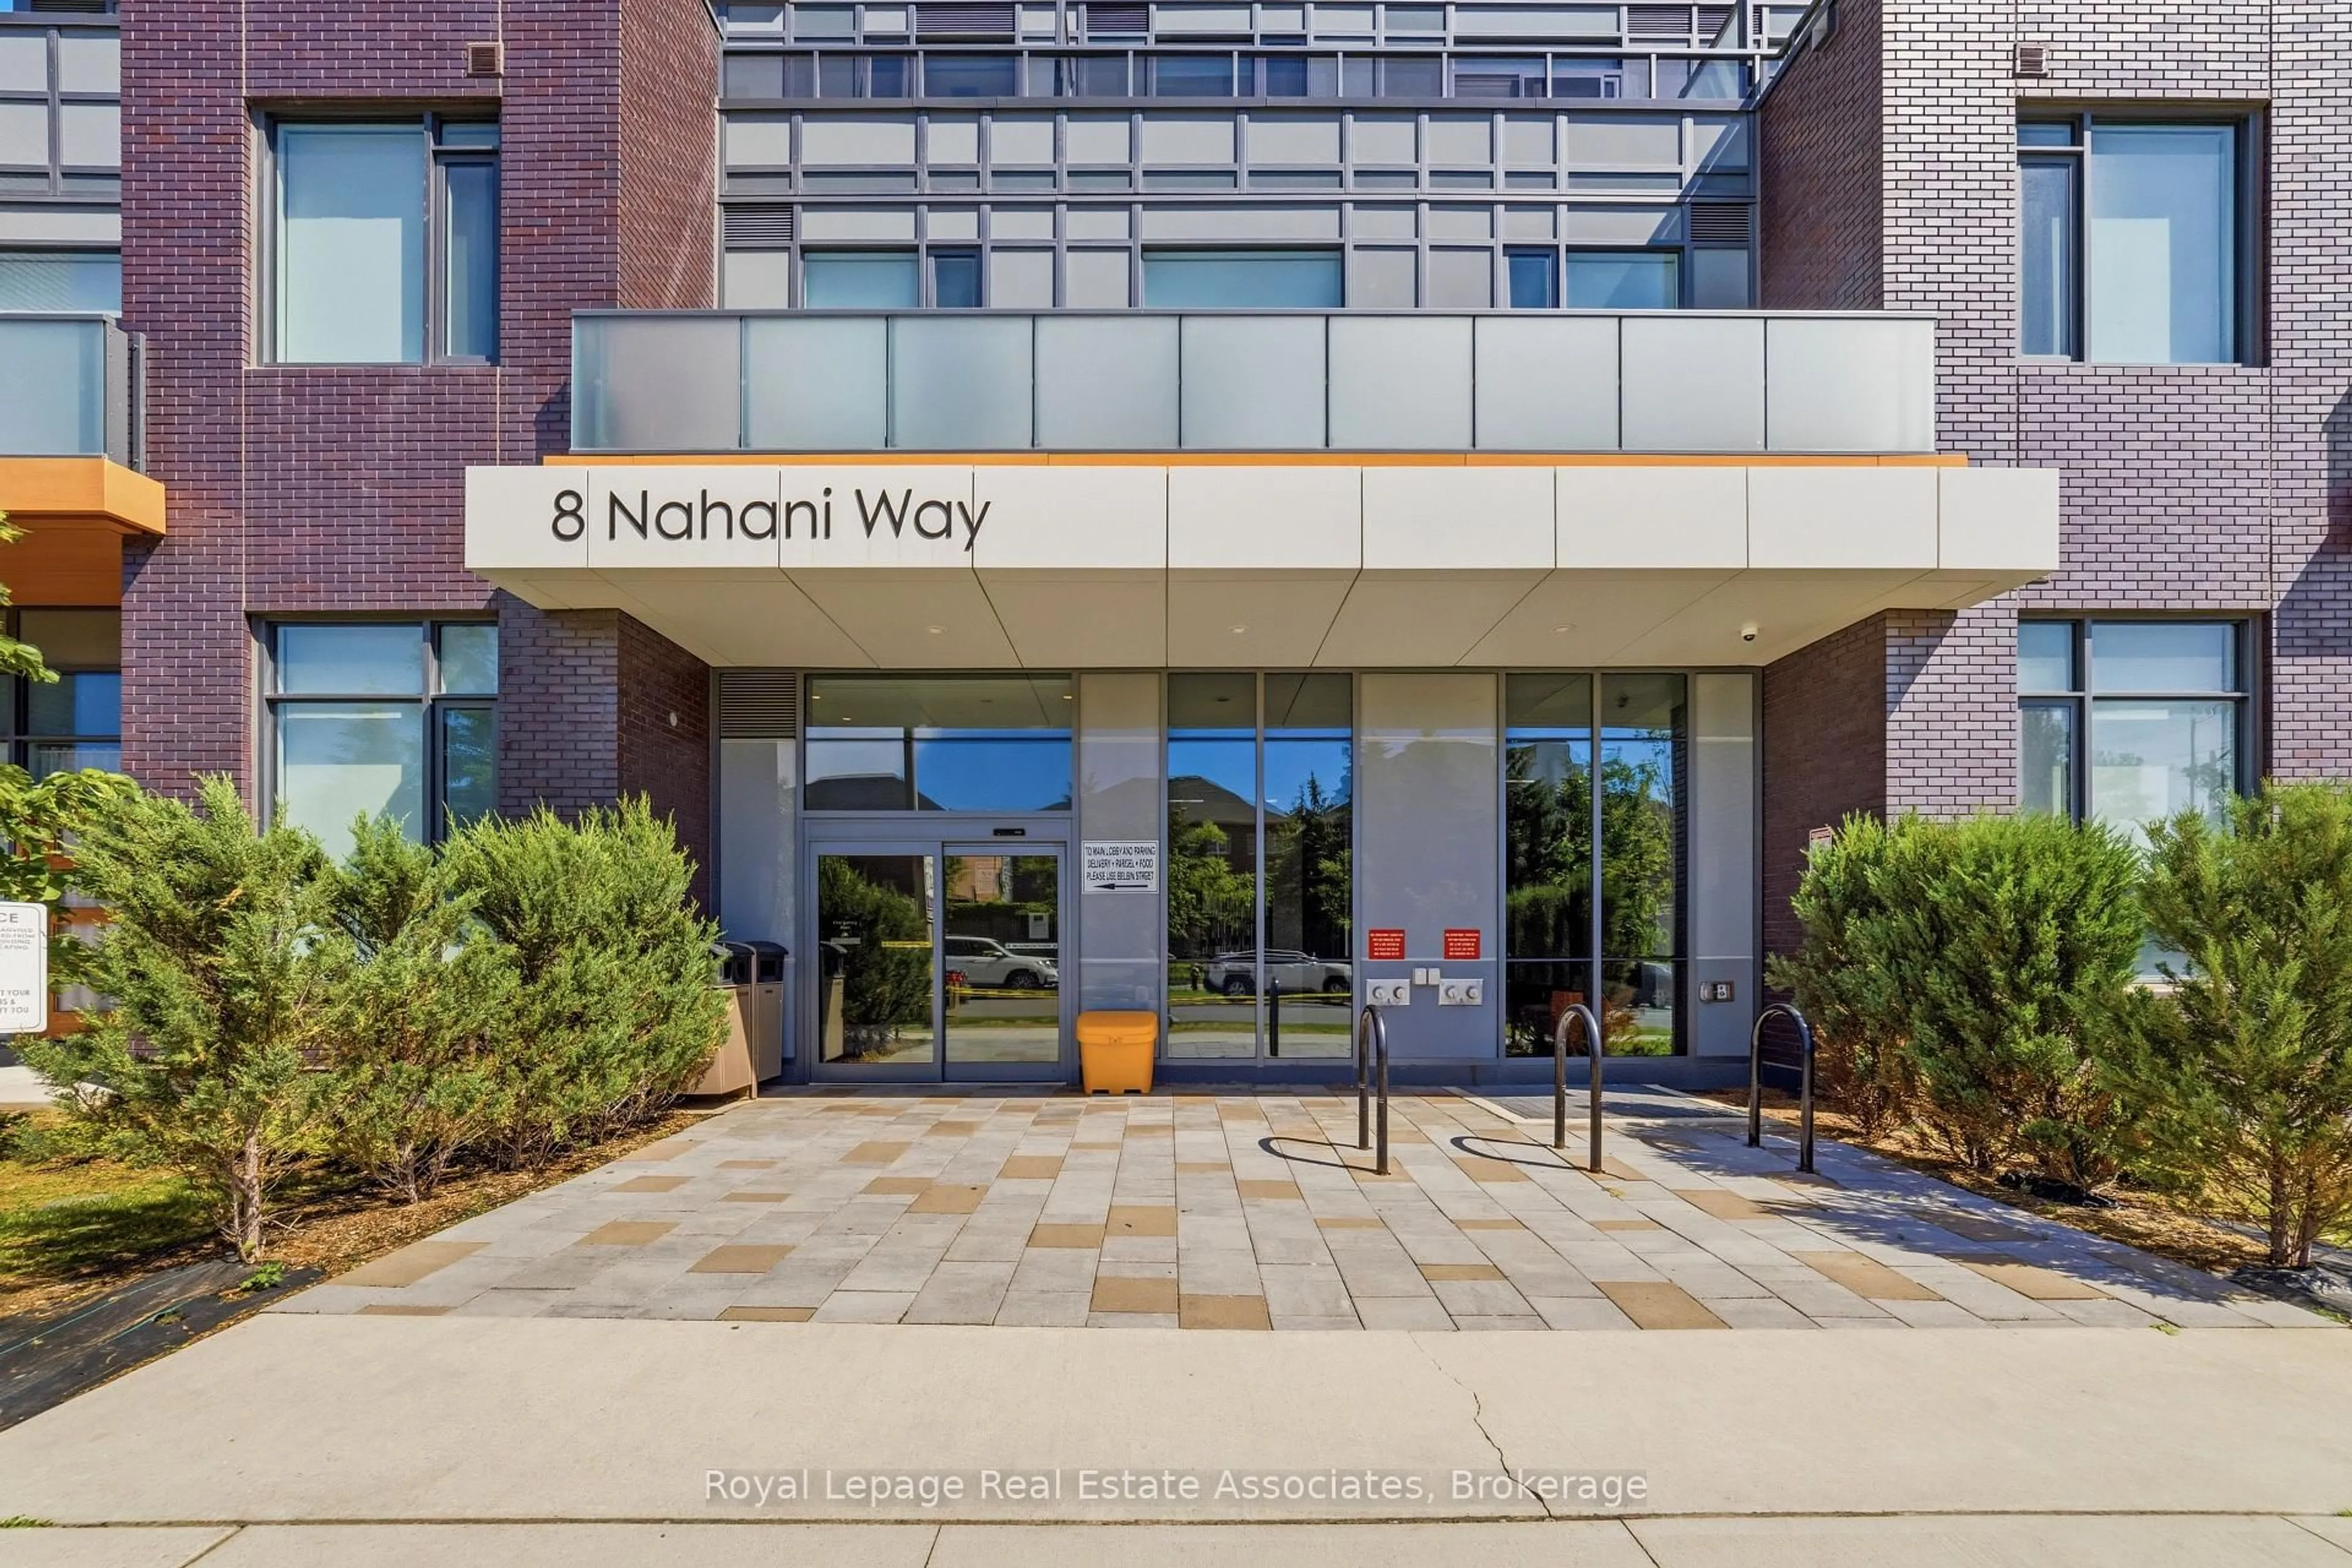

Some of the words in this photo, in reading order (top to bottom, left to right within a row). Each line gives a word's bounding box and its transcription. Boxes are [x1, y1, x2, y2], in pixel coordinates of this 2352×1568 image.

[551, 489, 586, 541] 8
[608, 488, 832, 541] Nahani
[854, 488, 992, 552] Way
[1085, 846, 1092, 856] TO
[1093, 846, 1105, 856] MAIN
[1106, 846, 1122, 856] LOBBY
[1122, 846, 1133, 856] AND
[1134, 846, 1156, 856] PARKING
[1088, 859, 1111, 868] DELIVERY
[1116, 859, 1135, 868] PARCEL
[1139, 859, 1153, 868] FOOD
[1087, 872, 1106, 880] PLEASE
[1106, 872, 1116, 880] USE
[1136, 871, 1153, 880] STREET
